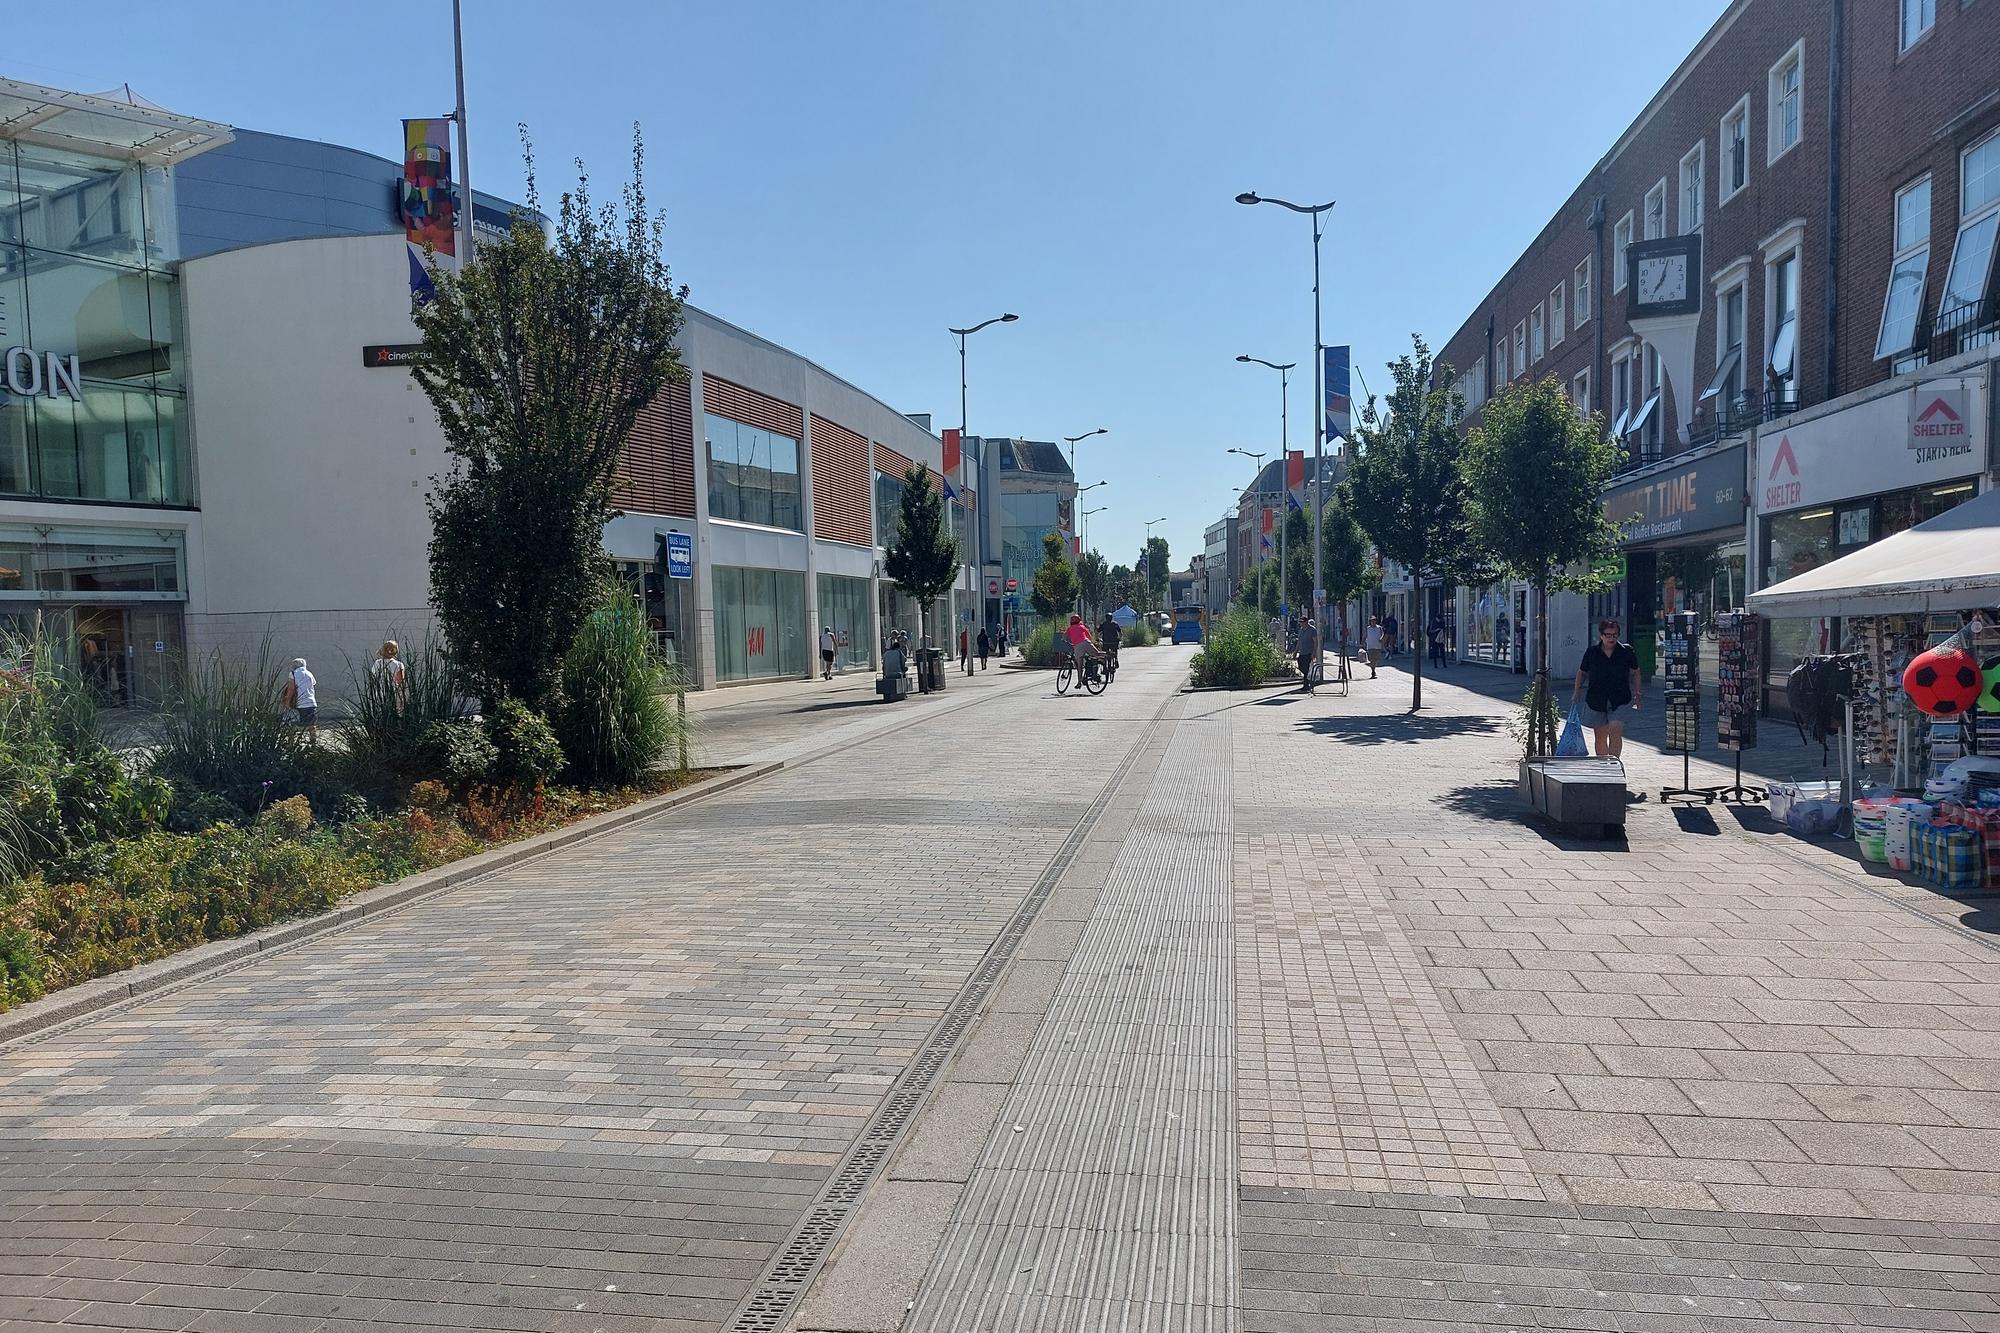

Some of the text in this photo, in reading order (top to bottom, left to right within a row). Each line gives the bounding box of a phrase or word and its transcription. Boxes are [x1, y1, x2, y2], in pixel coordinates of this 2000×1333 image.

[0, 345, 81, 402] ON
[1913, 423, 1965, 437] SHELTER
[1657, 472, 1697, 518] TIME
[1766, 481, 1801, 510] SHELTER
[1650, 517, 1682, 537] Restaurant
[668, 536, 690, 547] BUS LANE
[1009, 549, 1043, 559] BEACO
[671, 564, 691, 573] LOOK LEFT
